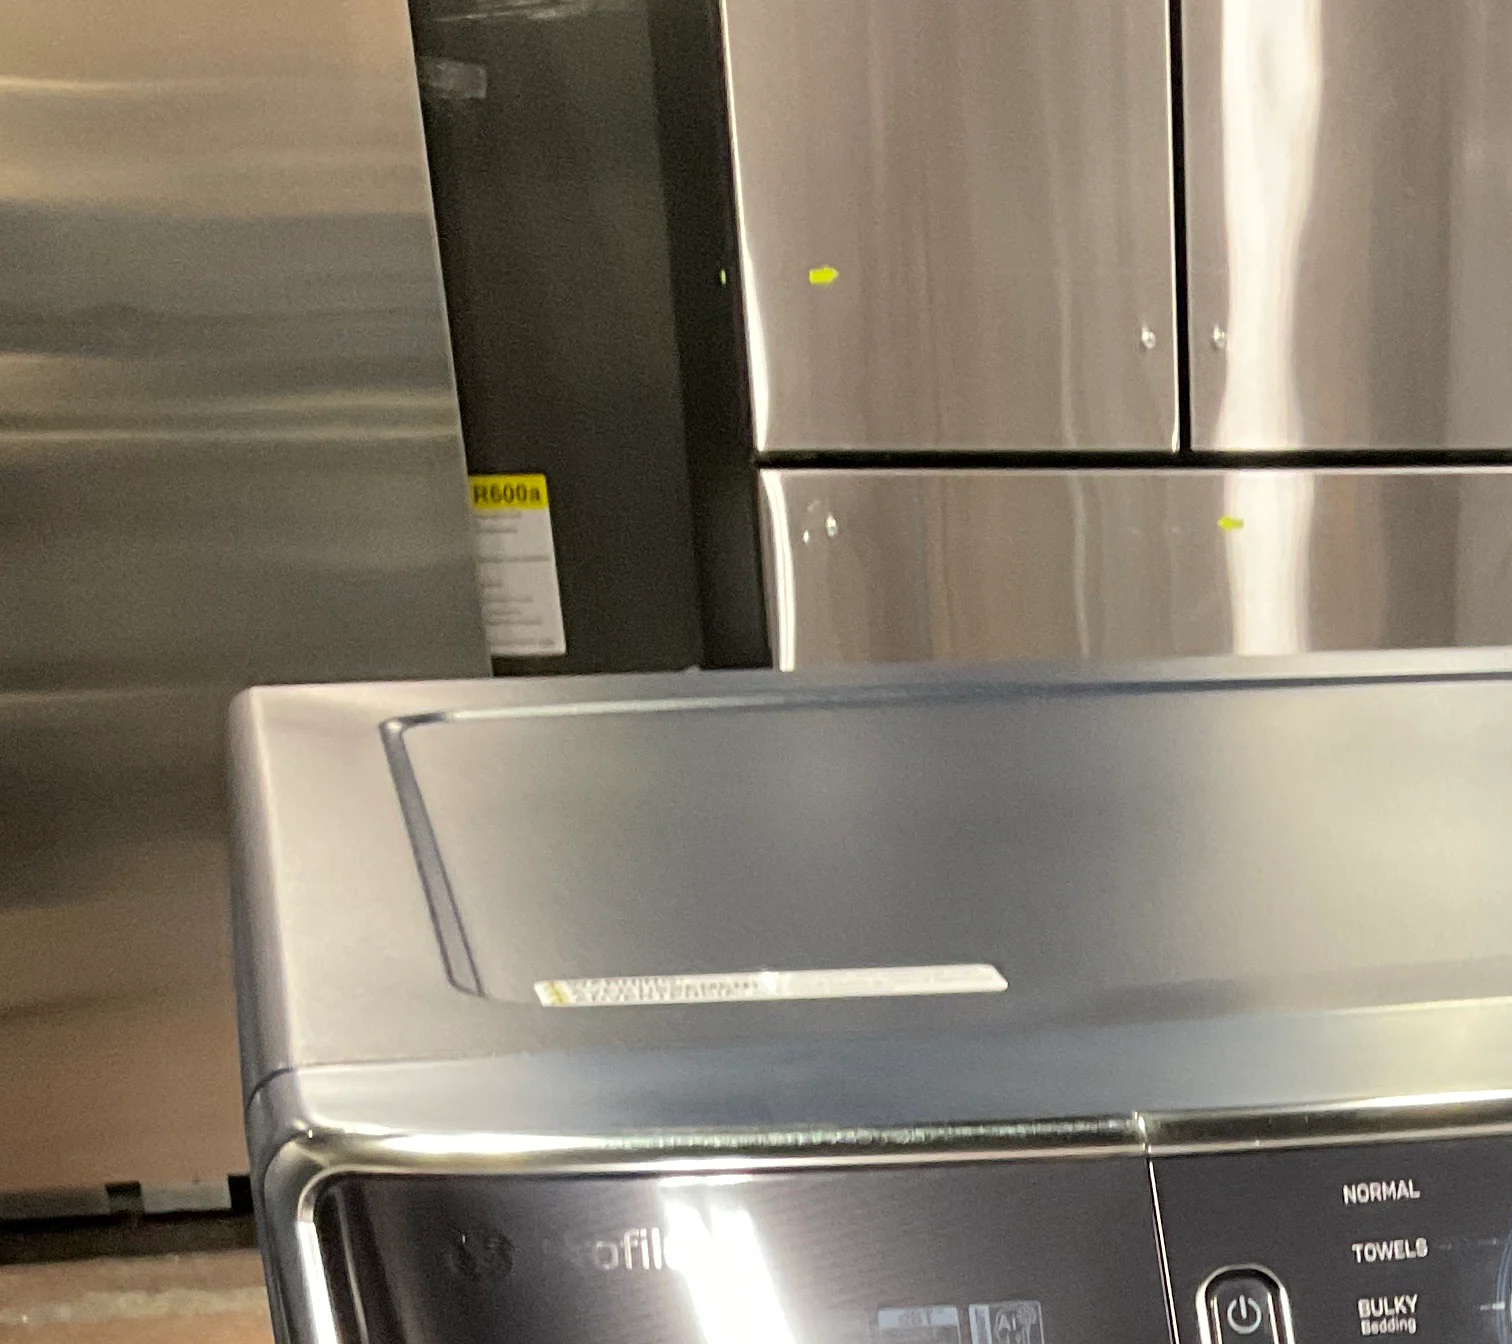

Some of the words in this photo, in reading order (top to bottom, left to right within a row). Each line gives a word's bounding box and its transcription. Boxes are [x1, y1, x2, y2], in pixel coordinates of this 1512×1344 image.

[1343, 1179, 1420, 1205] NORMAL
[1352, 1237, 1429, 1263] TOWELS
[1357, 1294, 1419, 1318] BULKY
[1360, 1314, 1417, 1336] Bedding
